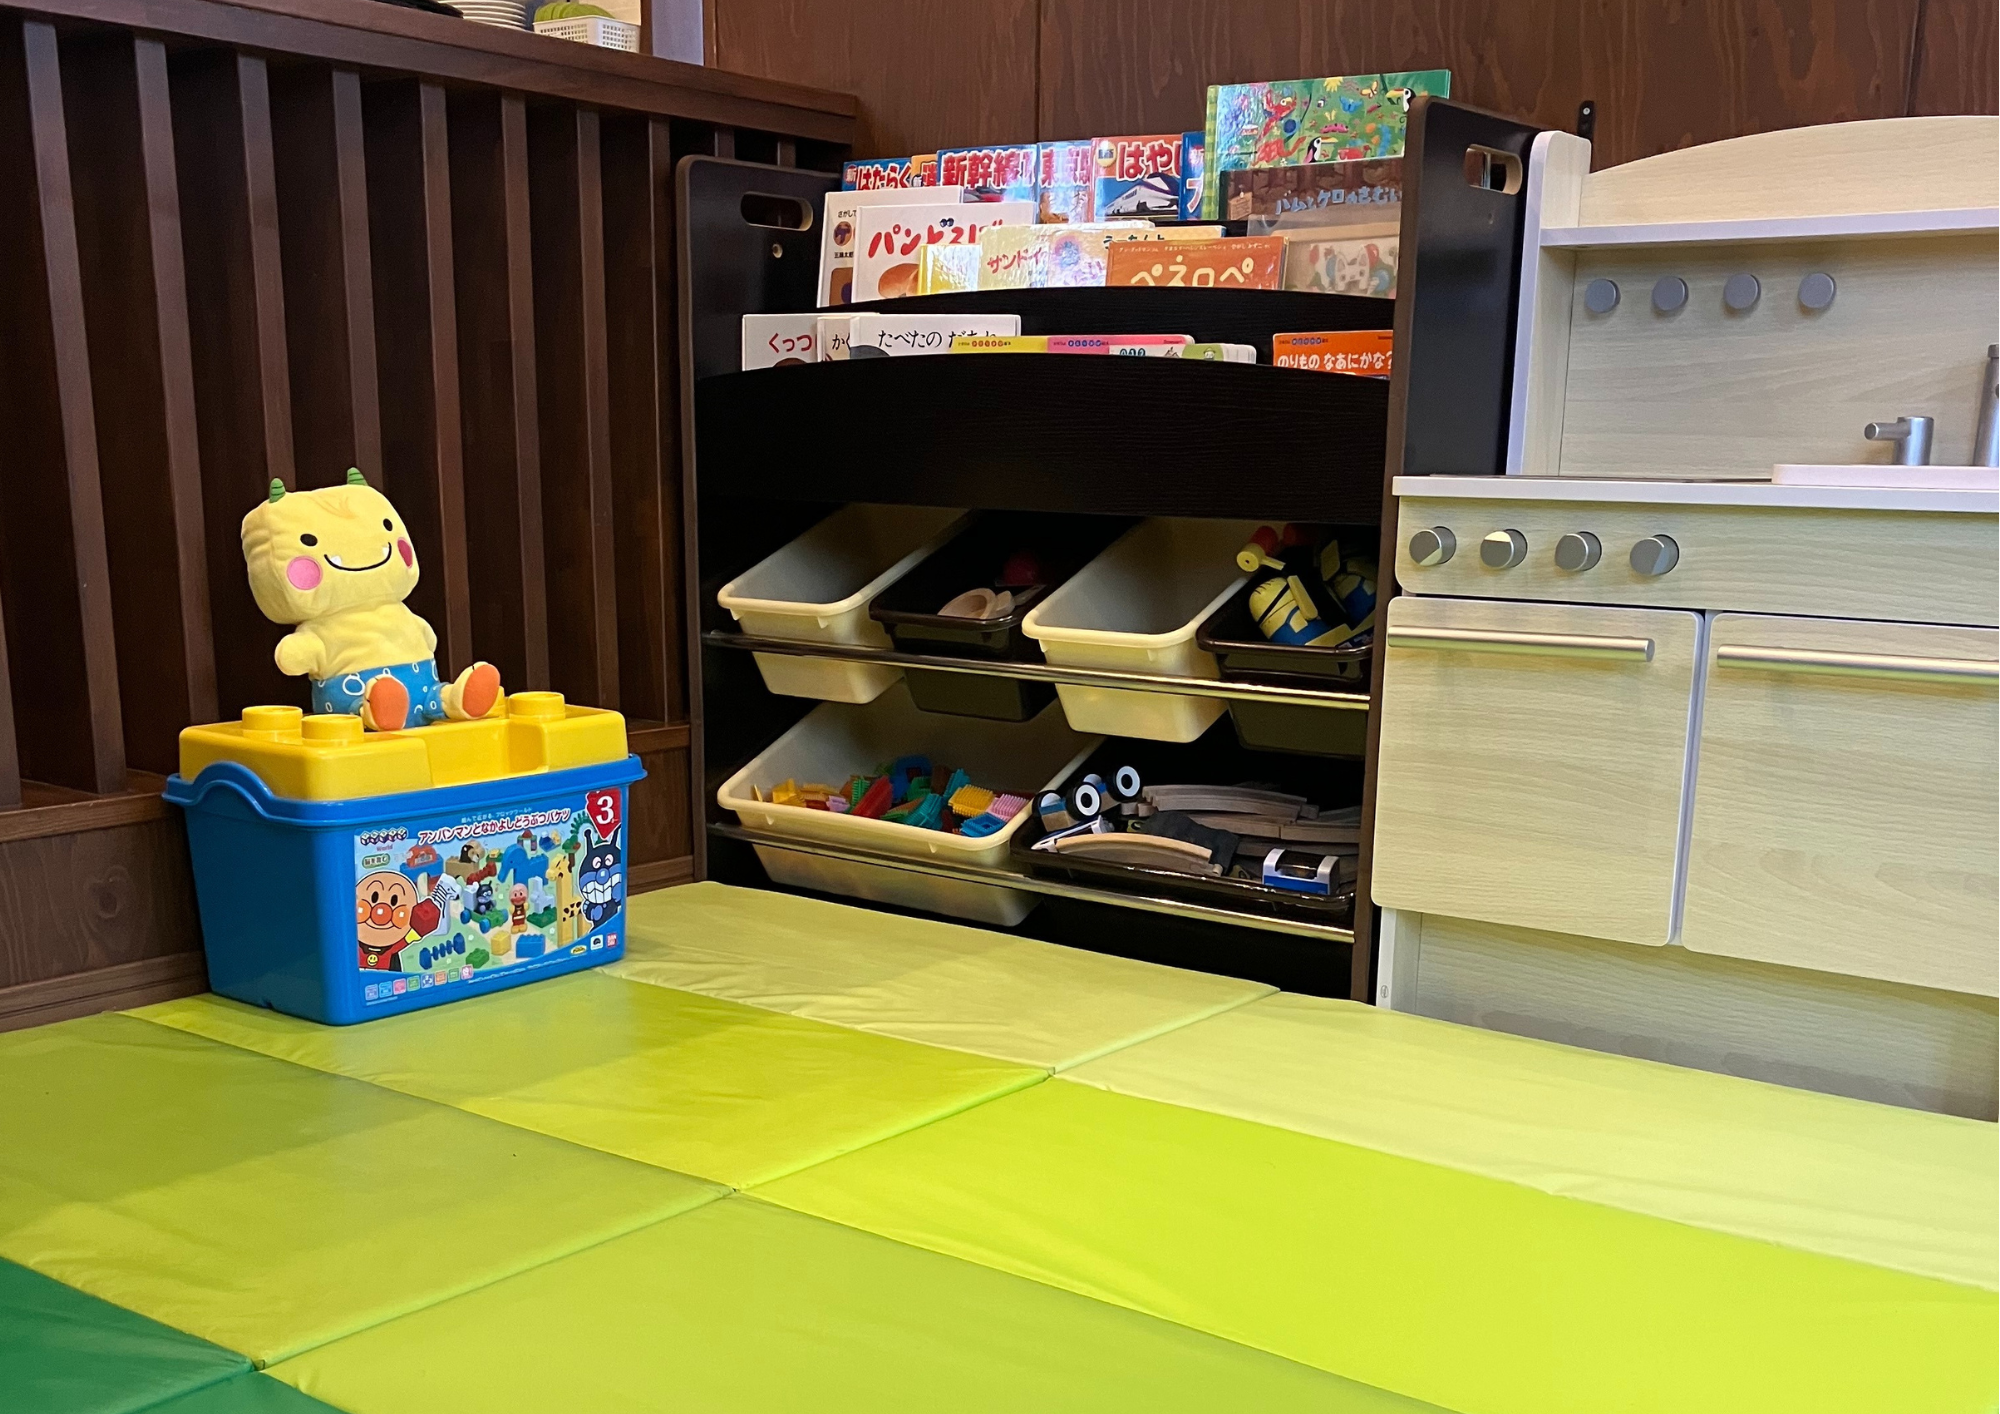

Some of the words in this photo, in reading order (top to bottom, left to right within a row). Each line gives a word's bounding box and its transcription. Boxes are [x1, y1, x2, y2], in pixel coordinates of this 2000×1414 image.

[857, 164, 911, 190] はたらく
[1131, 254, 1255, 287] ペネロペ
[768, 332, 817, 353] くっつ
[878, 330, 942, 348] たべたの
[1277, 353, 1321, 370] のりもの
[595, 795, 614, 825] 3
[418, 808, 571, 845] アンパンマンとなかよしどうぶつバケツ
